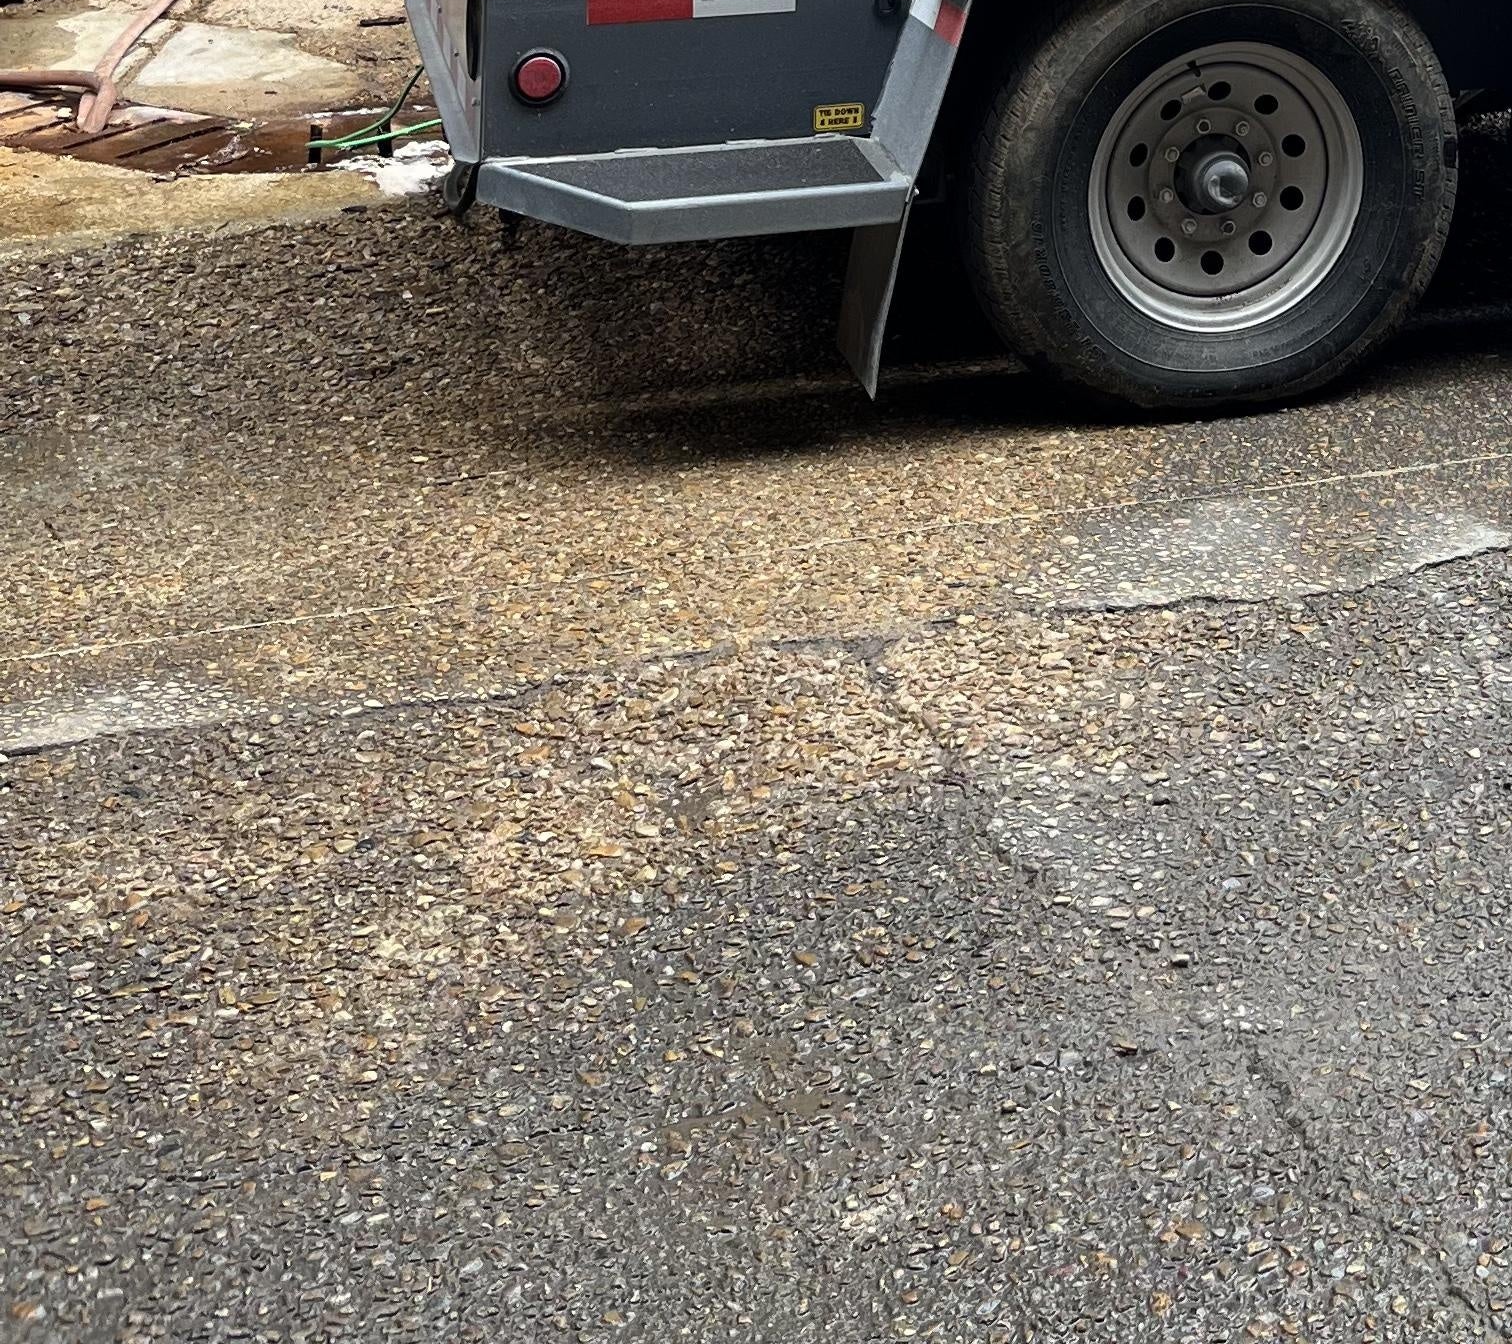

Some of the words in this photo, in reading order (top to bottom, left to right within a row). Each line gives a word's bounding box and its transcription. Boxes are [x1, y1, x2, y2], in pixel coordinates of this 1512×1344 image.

[819, 109, 832, 117] TIE
[834, 107, 860, 115] DOWN
[827, 117, 850, 125] HERE
